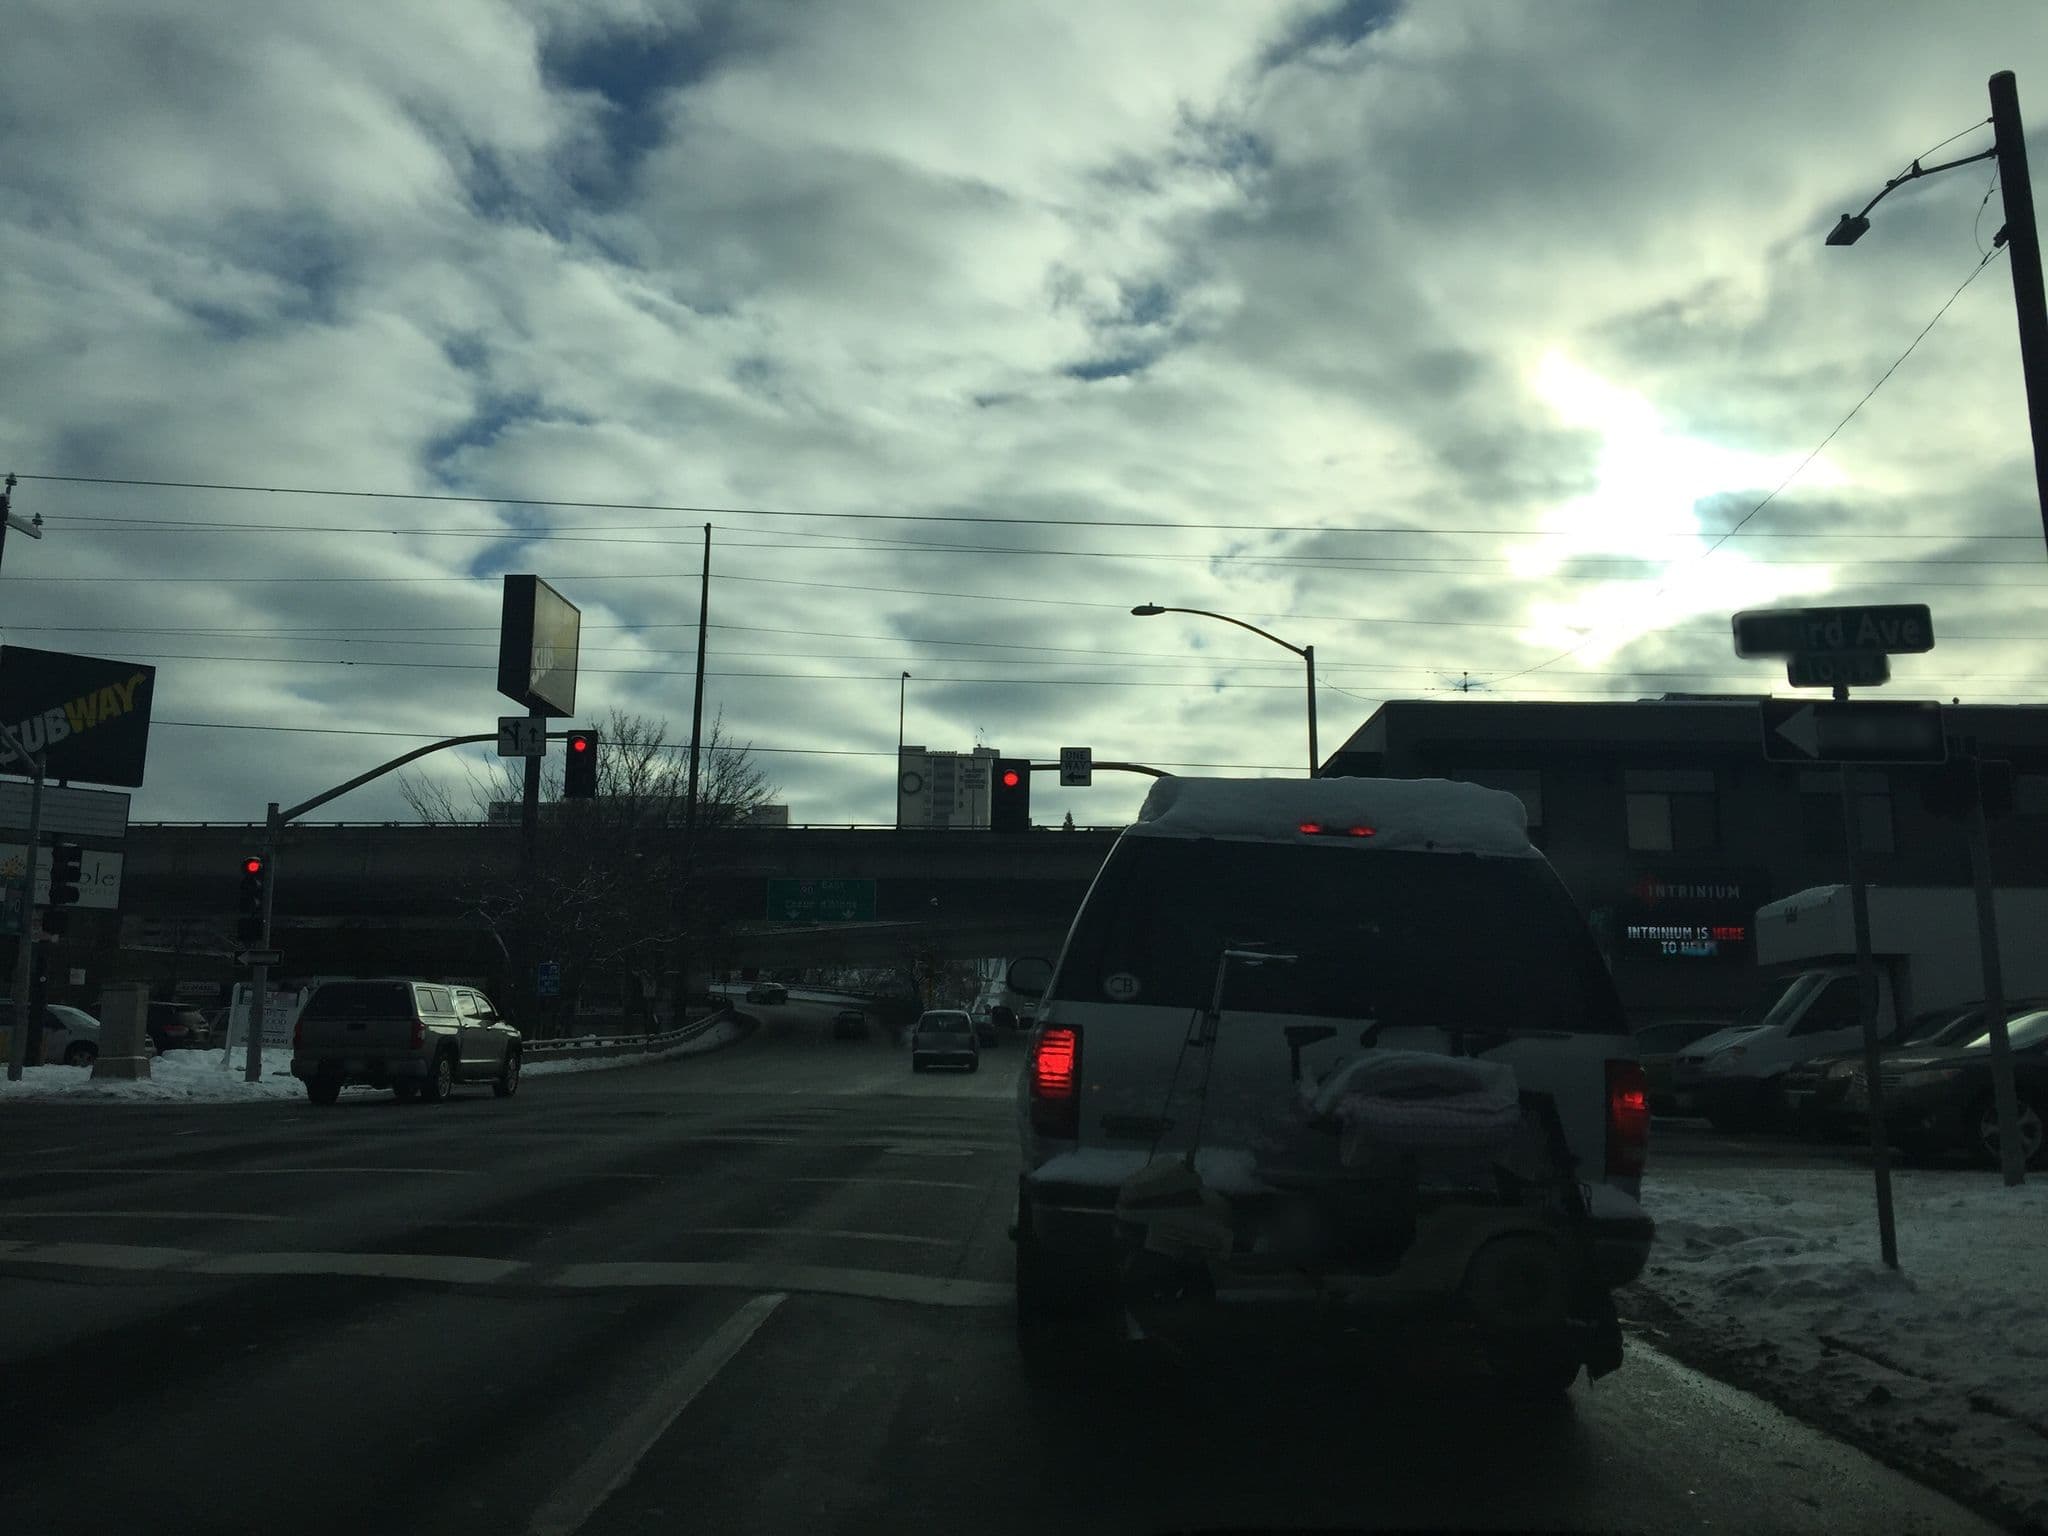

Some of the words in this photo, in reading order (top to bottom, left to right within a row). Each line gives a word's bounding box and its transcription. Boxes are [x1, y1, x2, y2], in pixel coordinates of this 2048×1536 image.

[1856, 612, 1921, 646] Ave
[1065, 751, 1086, 760] ONE
[1065, 761, 1087, 771] WAY
[1648, 883, 1741, 899] INTRINIUM
[1627, 926, 1693, 940] INTRINIUM
[1697, 926, 1709, 940] IS
[1661, 941, 1678, 954] TO
[1110, 976, 1133, 993] CB
